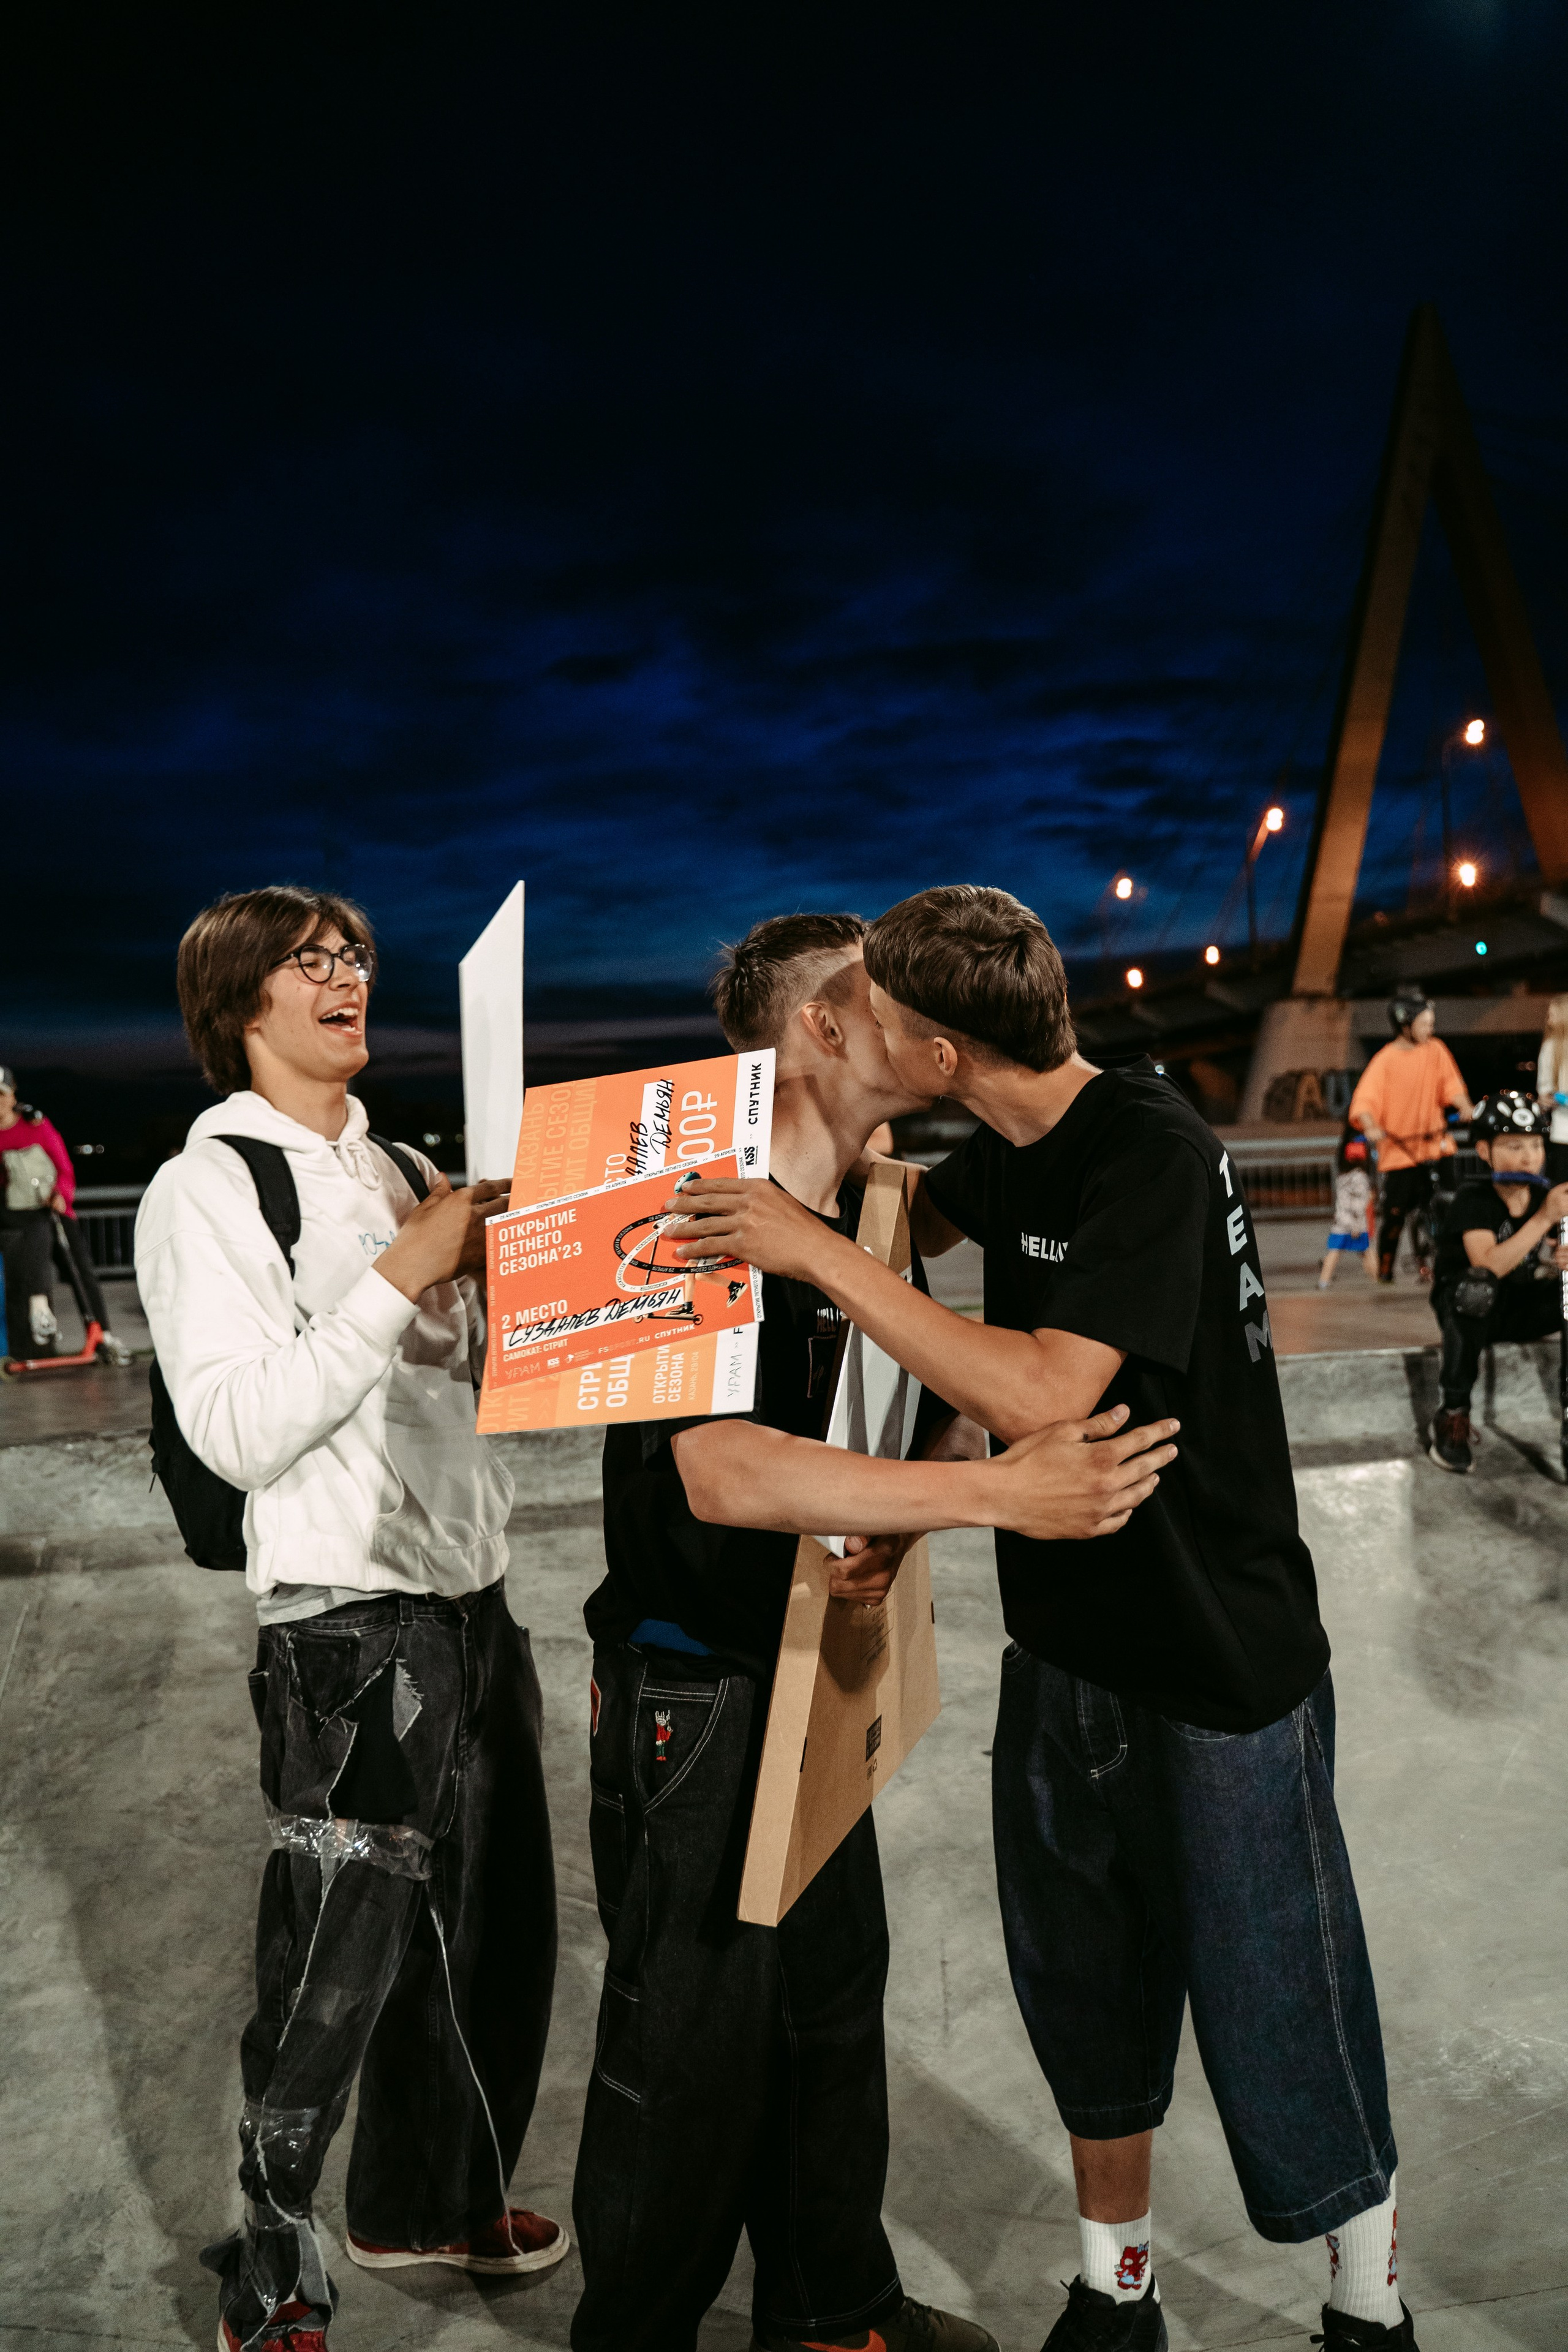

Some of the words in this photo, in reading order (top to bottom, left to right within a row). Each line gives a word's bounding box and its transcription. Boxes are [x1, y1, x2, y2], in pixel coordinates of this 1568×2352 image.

[748, 1063, 761, 1125] СПУТНИК
[650, 1079, 674, 1154] ДЕМЬЯН
[677, 1090, 717, 1160] 00₽
[515, 1102, 545, 1180] КАЗАНЬ
[744, 1147, 755, 1166] KSS
[537, 1144, 564, 1200] ЫТИЕ
[562, 1157, 587, 1197] РИТ
[603, 1153, 627, 1185] СТО
[498, 1230, 562, 1259] ЛЕТНЕГО
[499, 1208, 577, 1242] ОТКРЫТИЕ
[1219, 1150, 1273, 1363] TEAM
[501, 1314, 511, 1330] 2
[516, 1299, 568, 1325] МЕСТО
[604, 1289, 681, 1323] ДЕМЬЯН
[543, 1338, 568, 1352] СТРИТ
[654, 1323, 695, 1340] СПУТНИК
[505, 1362, 541, 1379] УРАМ
[605, 1354, 635, 1408] ОБЩ
[652, 1344, 670, 1403] ОТКРЫТИ
[668, 1352, 684, 1403] СЕЗОНА
[690, 1351, 699, 1371] 29/04
[727, 1354, 742, 1397] УРАМ
[578, 1362, 603, 1411] СТР
